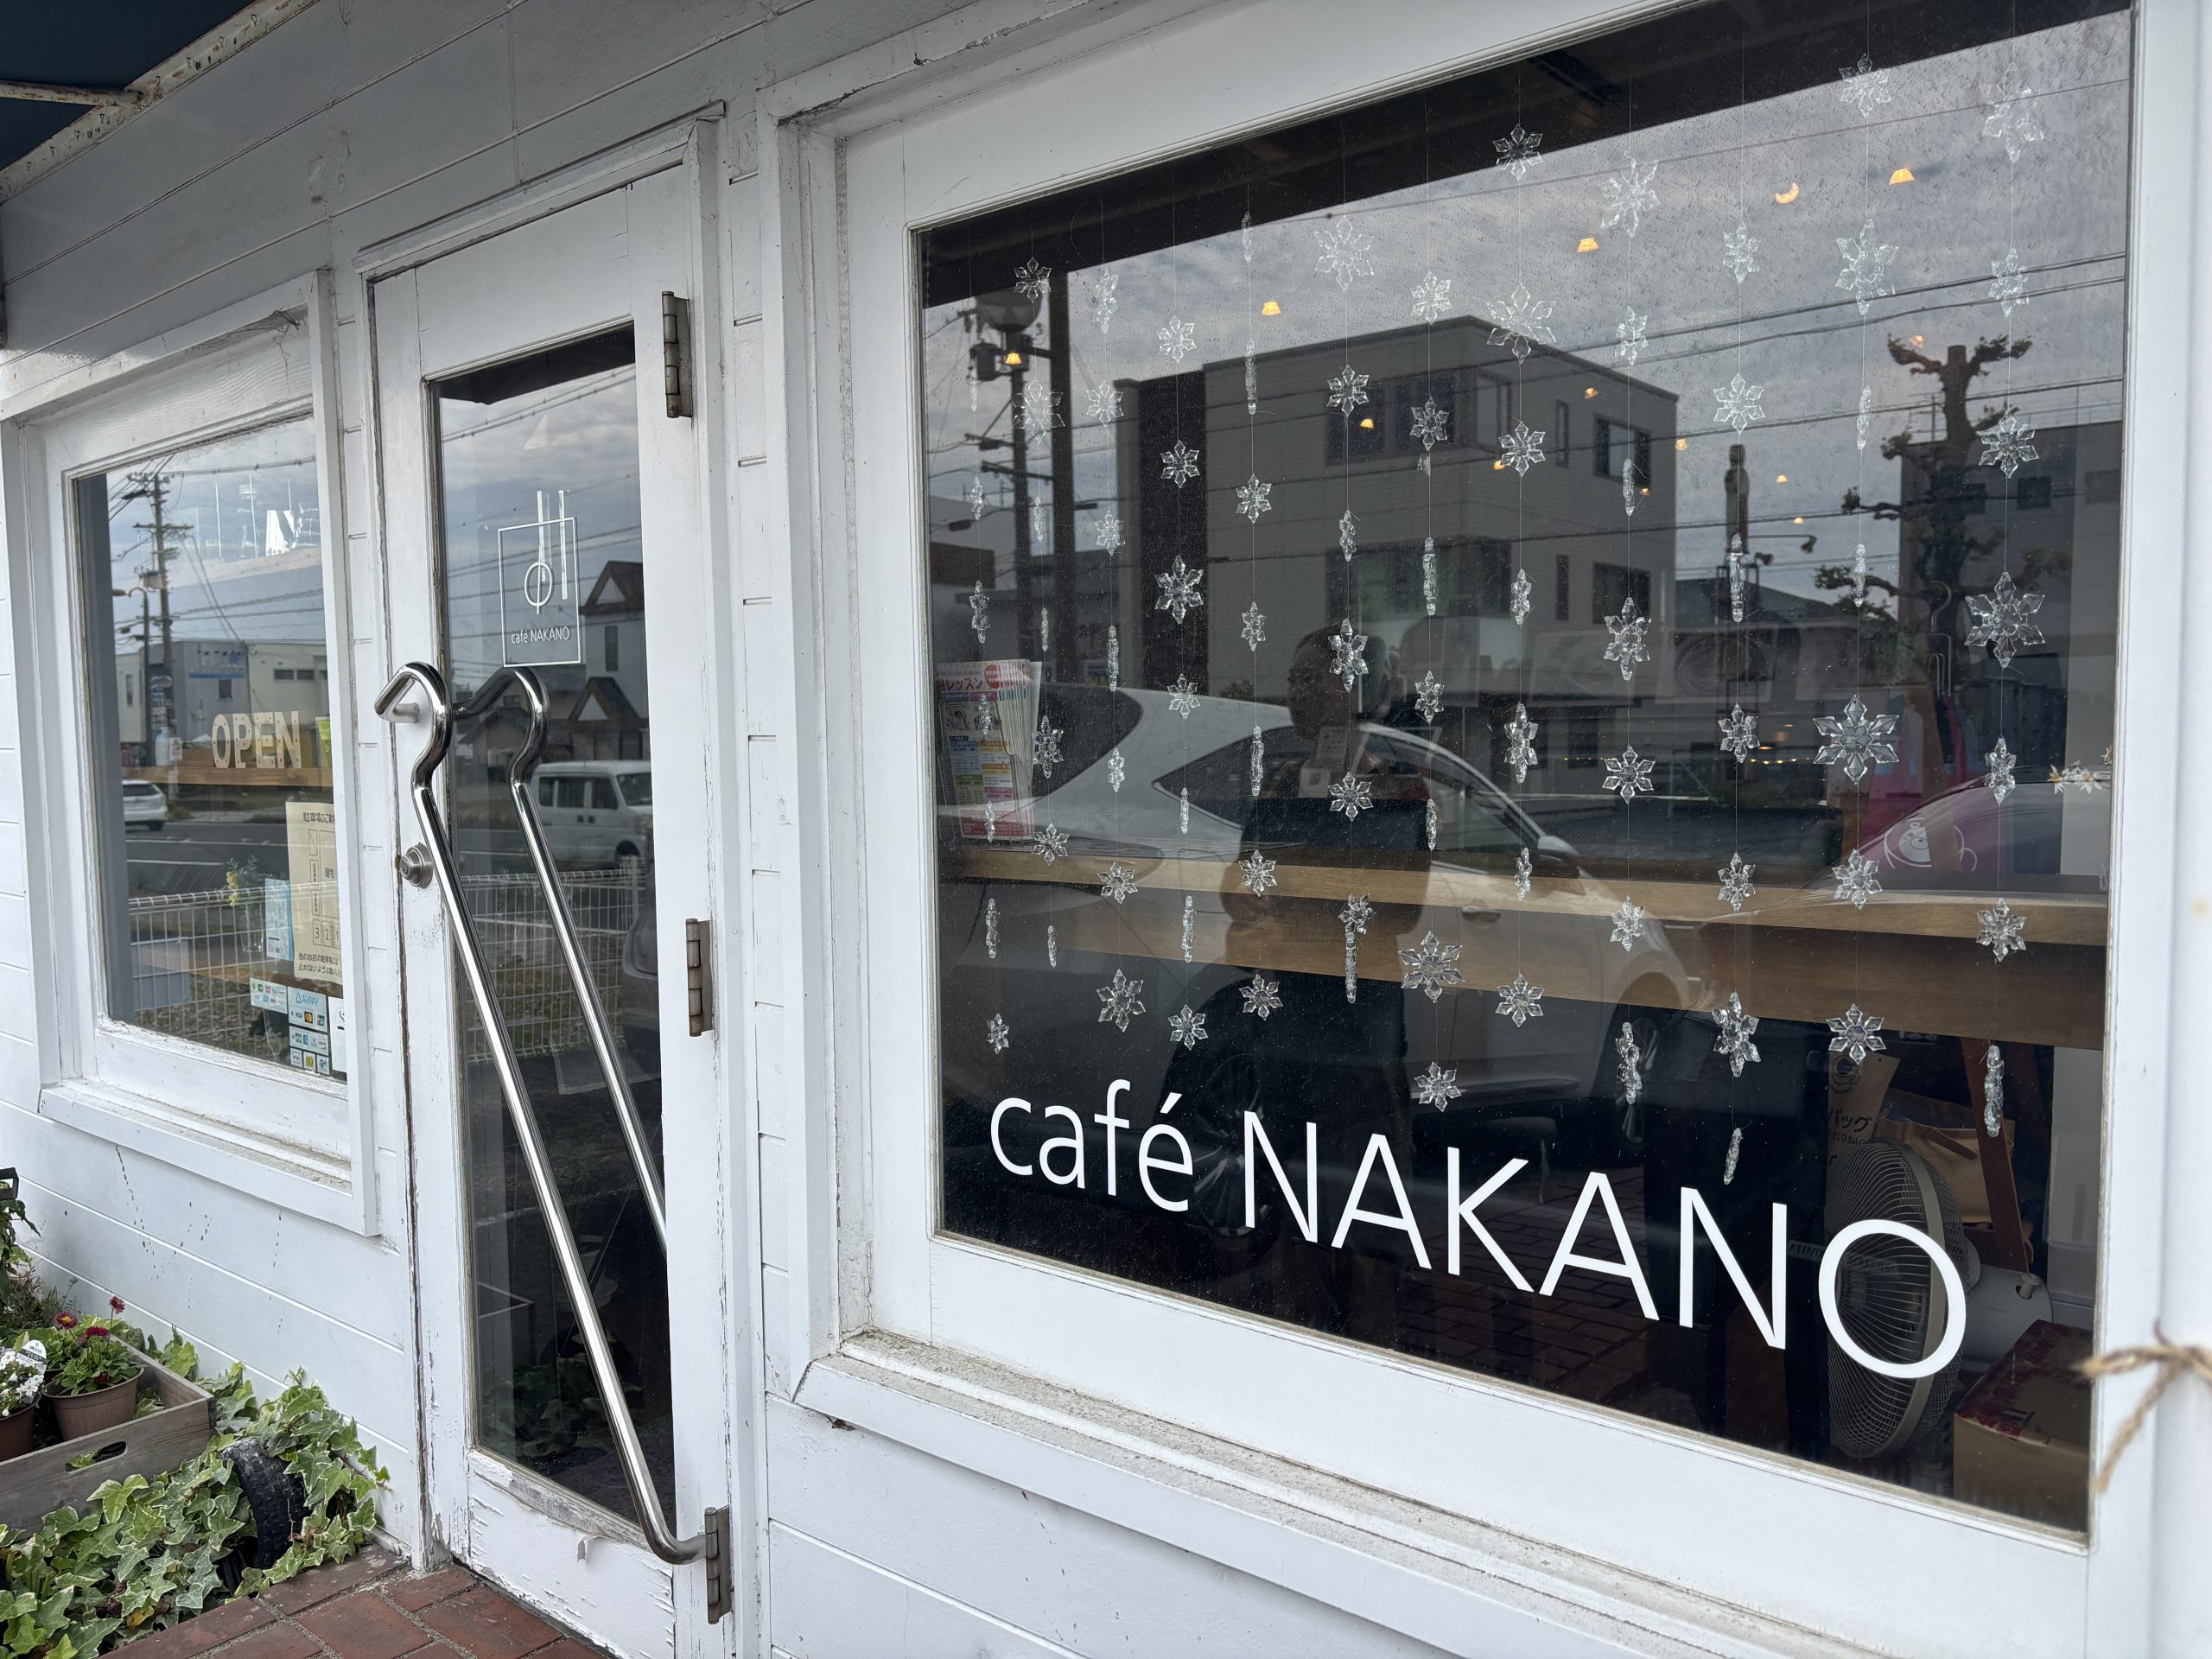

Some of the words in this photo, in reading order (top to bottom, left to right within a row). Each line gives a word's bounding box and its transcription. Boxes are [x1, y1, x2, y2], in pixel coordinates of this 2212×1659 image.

[511, 629, 529, 644] café
[530, 626, 569, 642] NAKANO
[212, 710, 302, 769] OPEN
[315, 927, 320, 939] 3
[325, 928, 329, 941] 2
[990, 1079, 1193, 1212] café
[1243, 1110, 1967, 1380] NAKANO
